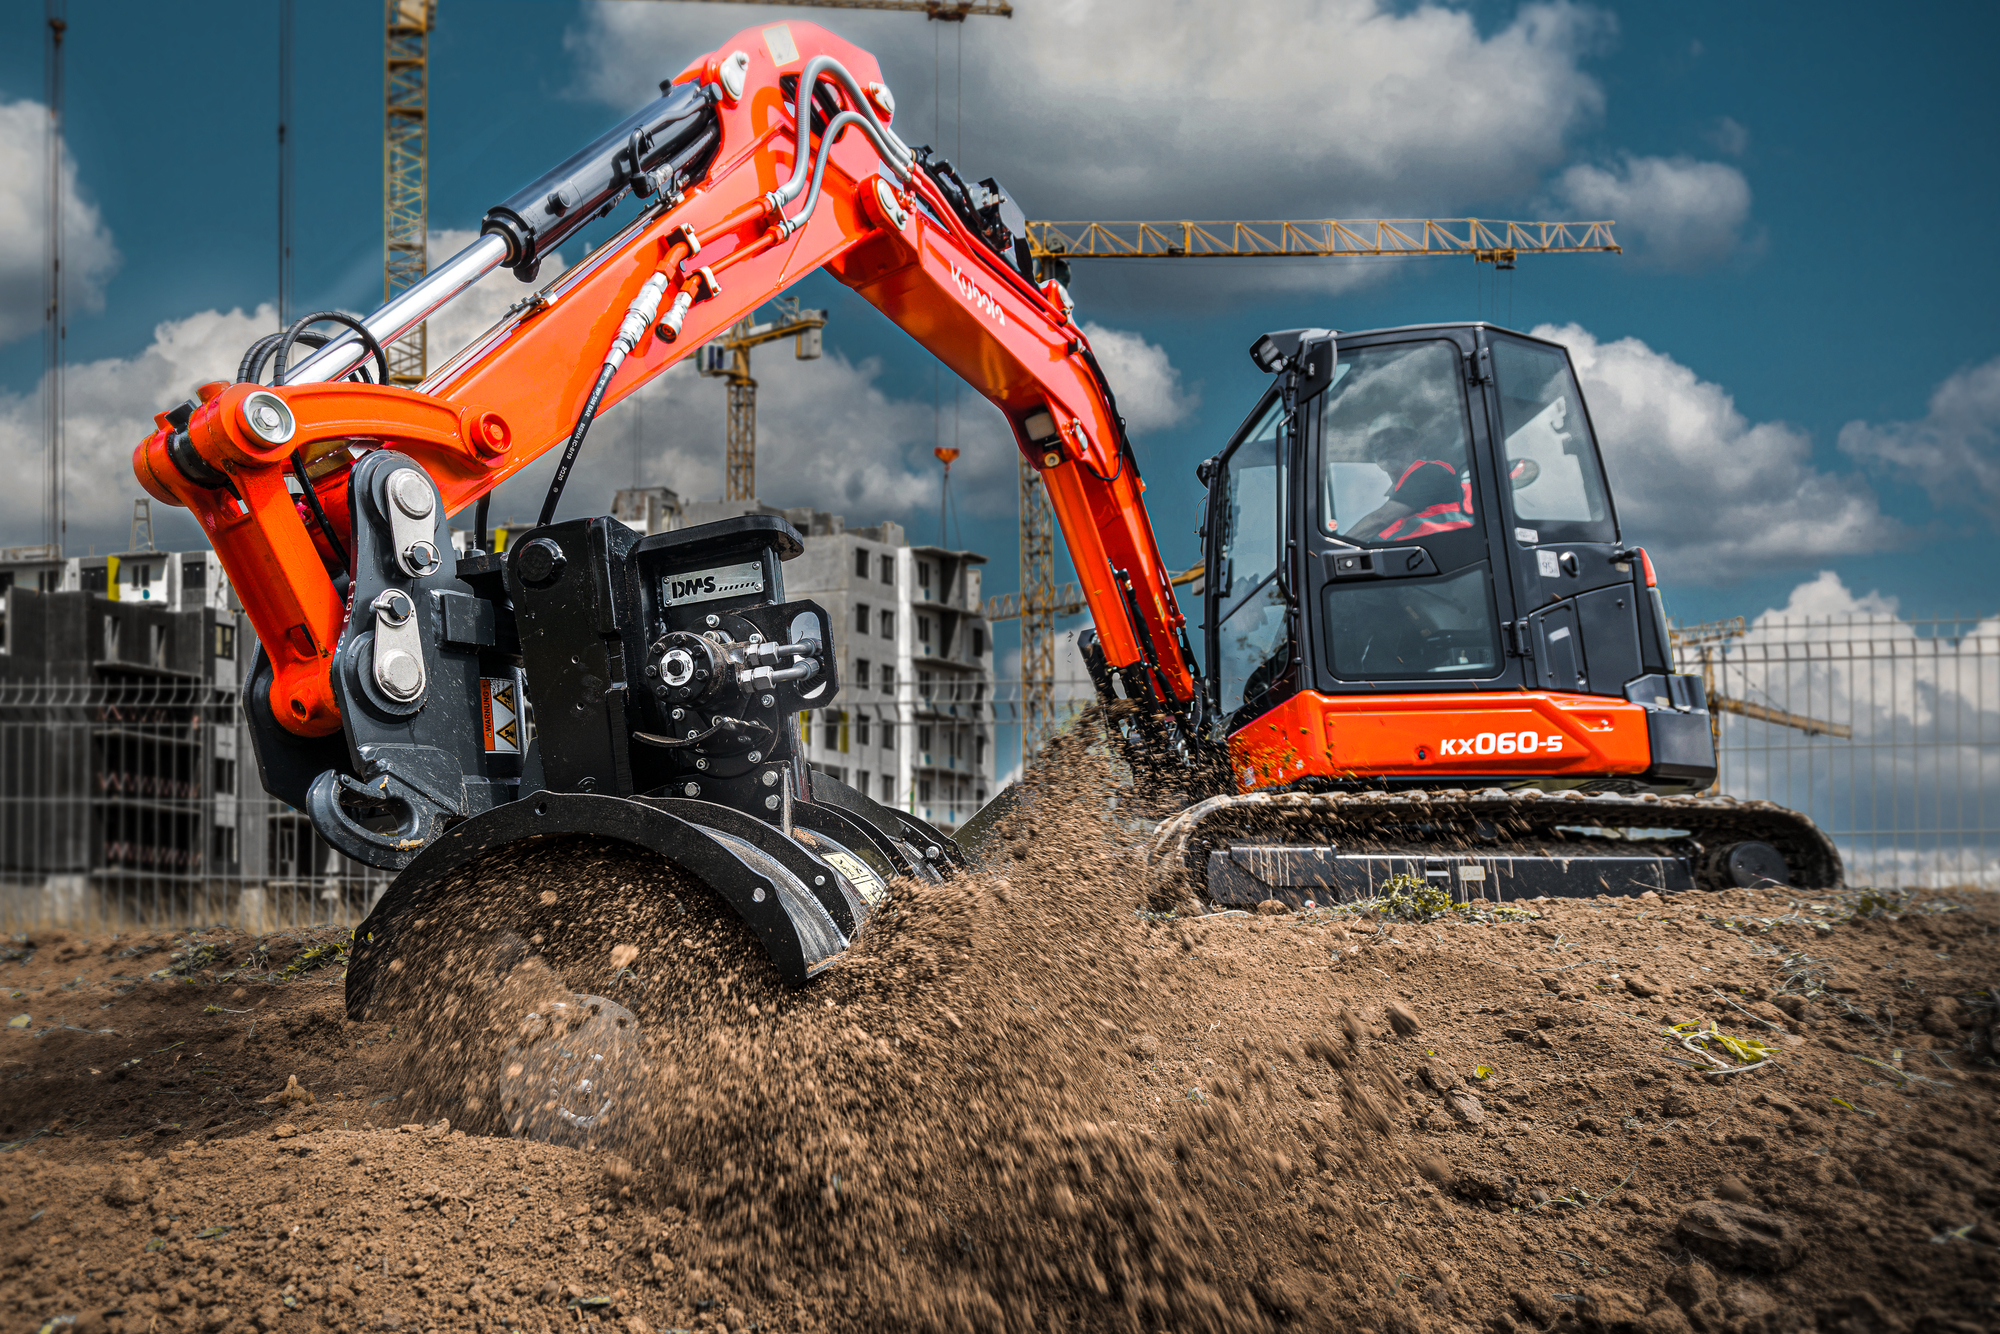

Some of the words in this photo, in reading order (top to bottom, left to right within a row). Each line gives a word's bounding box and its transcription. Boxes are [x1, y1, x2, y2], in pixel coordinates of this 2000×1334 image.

[950, 260, 1006, 326] Kubota
[671, 576, 716, 599] DMS
[482, 691, 492, 732] WARNUNG
[1440, 731, 1563, 755] KX060-5
